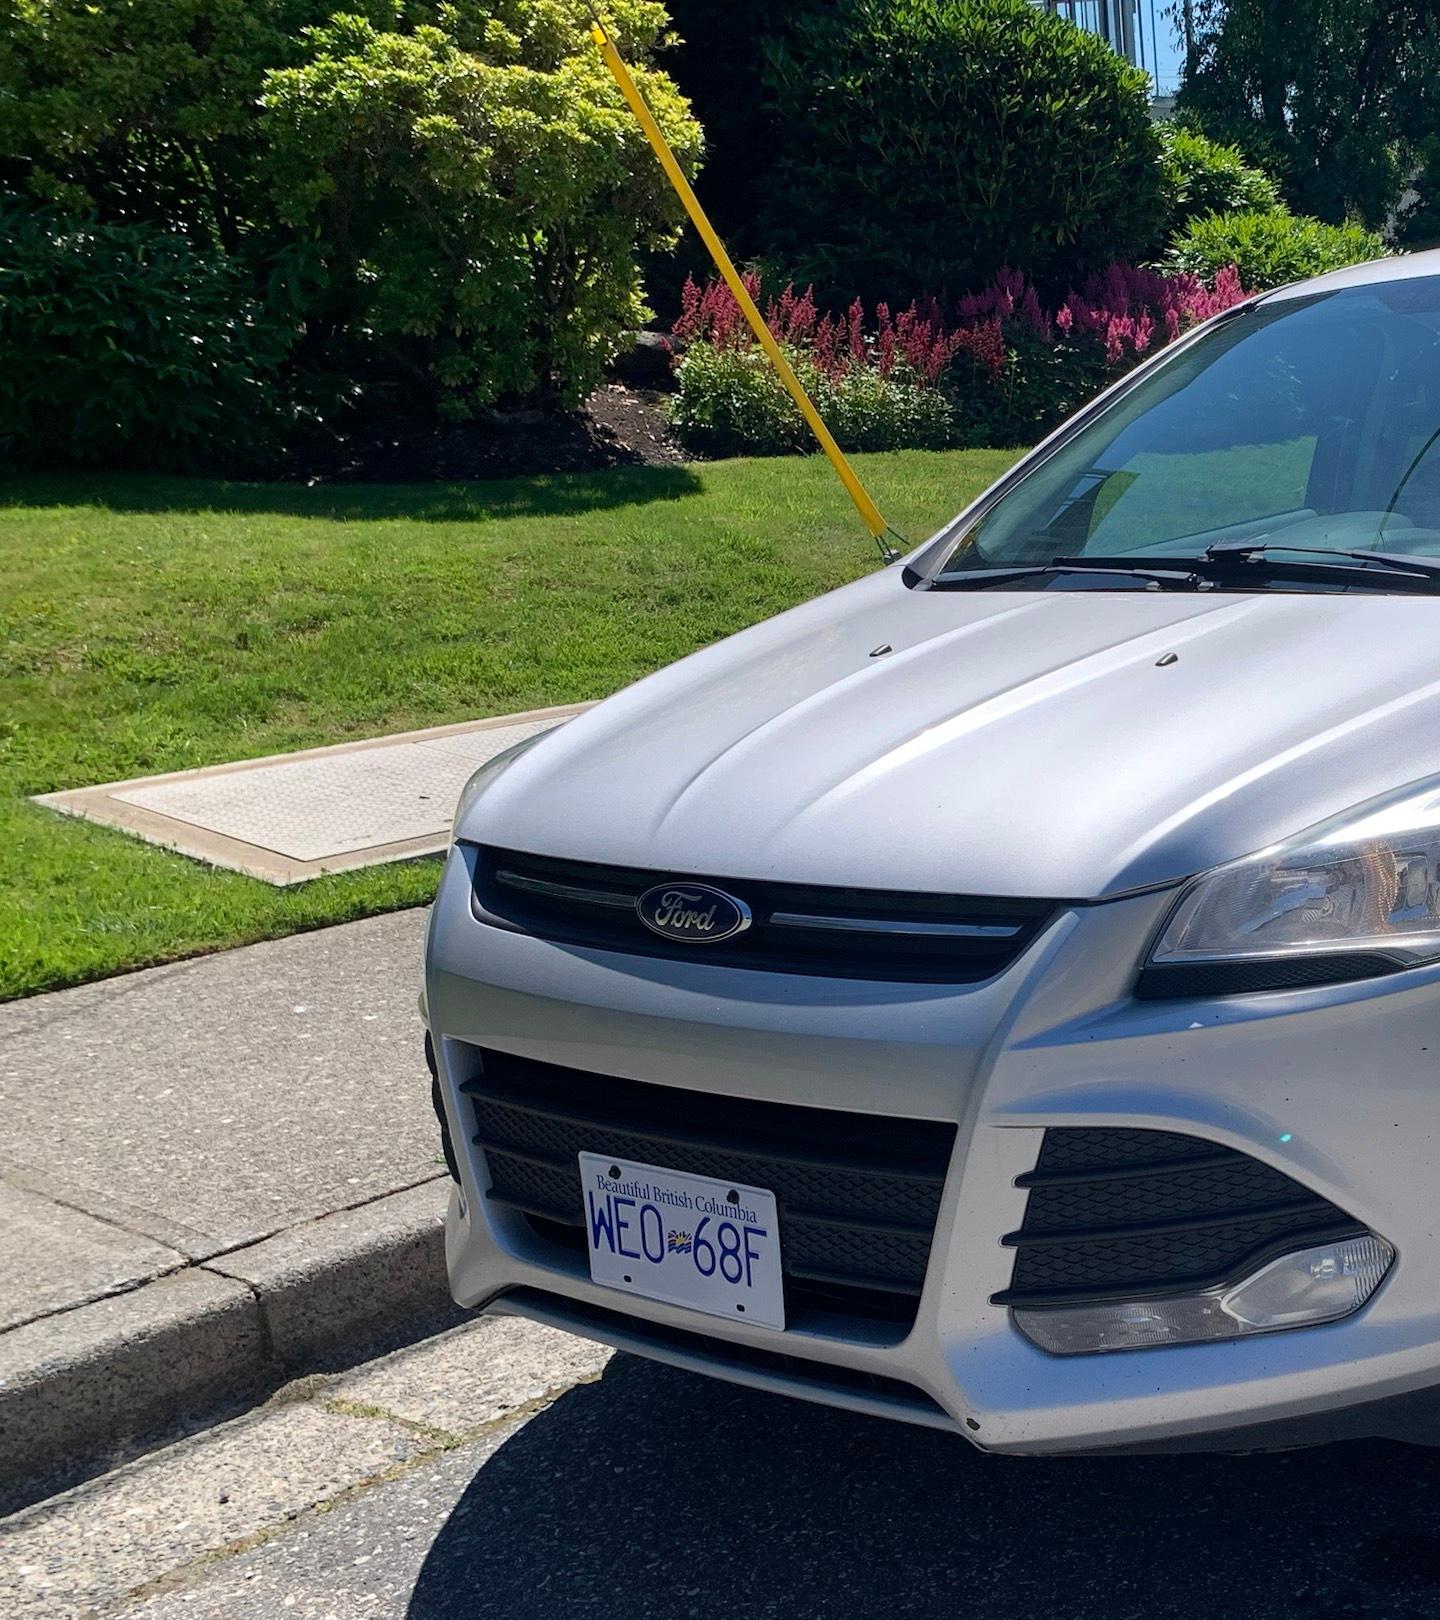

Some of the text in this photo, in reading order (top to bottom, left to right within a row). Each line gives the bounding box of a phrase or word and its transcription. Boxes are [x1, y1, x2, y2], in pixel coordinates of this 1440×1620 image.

[655, 891, 717, 930] Ford
[597, 1174, 757, 1223] Beautiful British Columbia
[693, 1216, 767, 1288] 68F
